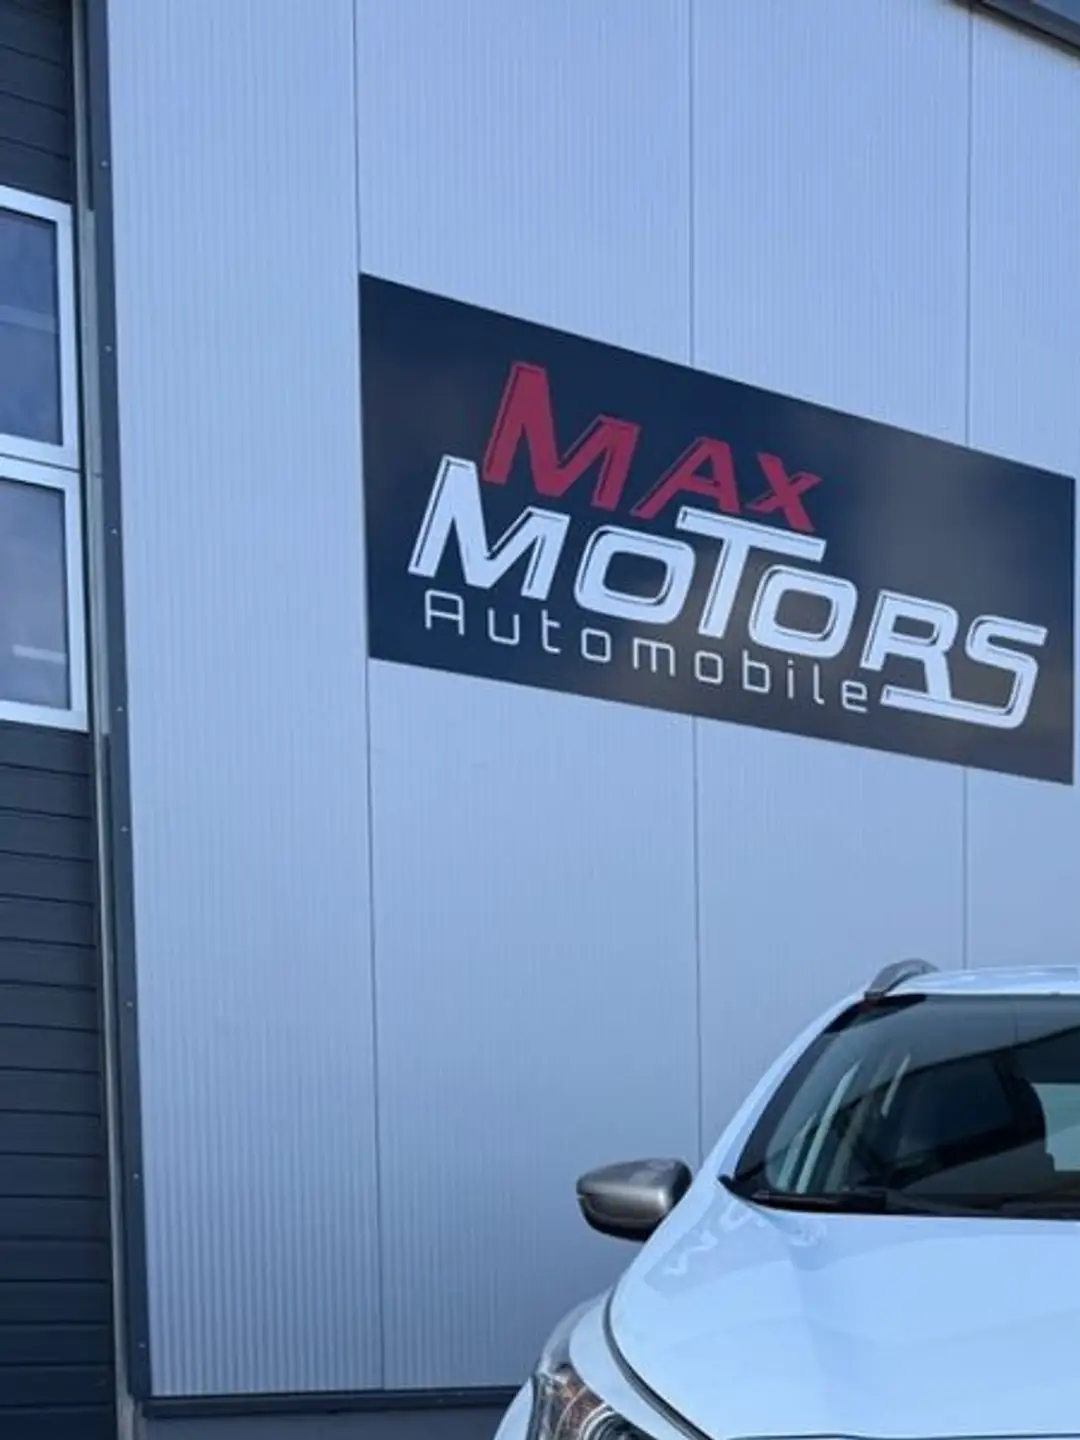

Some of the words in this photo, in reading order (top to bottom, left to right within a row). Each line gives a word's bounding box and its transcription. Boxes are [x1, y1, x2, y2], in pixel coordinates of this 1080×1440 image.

[482, 360, 822, 533] MAX
[407, 455, 1048, 729] MOTORS
[425, 589, 869, 714] Automobile
